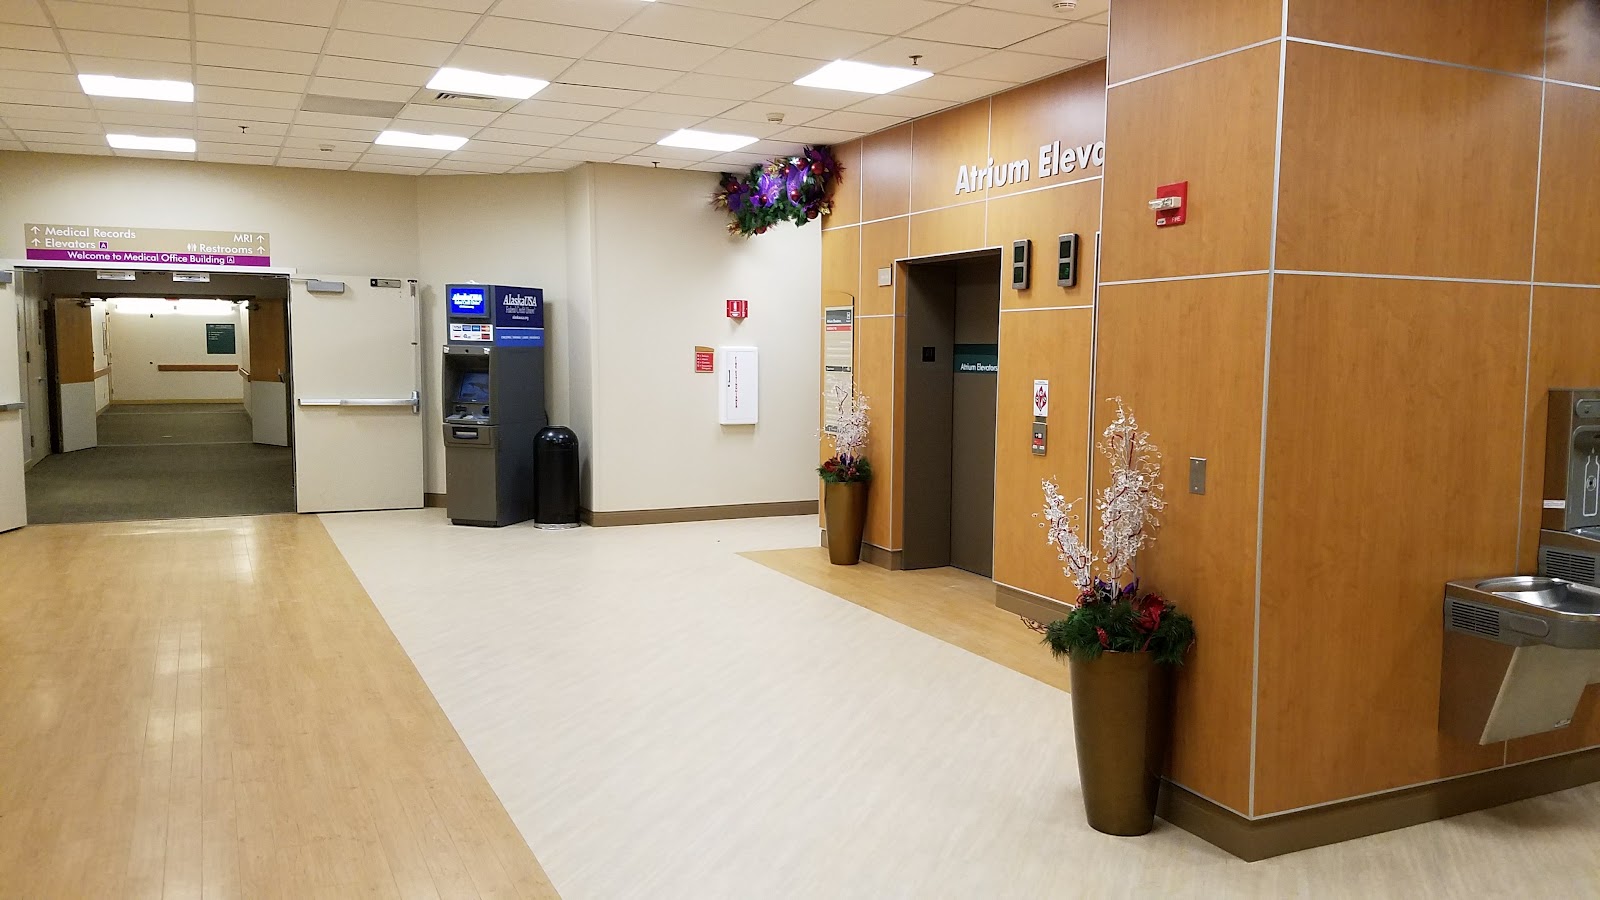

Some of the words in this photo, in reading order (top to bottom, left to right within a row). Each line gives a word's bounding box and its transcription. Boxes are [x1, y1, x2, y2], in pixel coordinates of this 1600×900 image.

[955, 156, 1030, 195] Atrium
[44, 226, 90, 237] Medical
[93, 228, 136, 239] Records
[233, 233, 253, 243] MRI
[45, 238, 96, 249] Elevators
[199, 243, 253, 254] Restrooms
[67, 251, 110, 261] Welcome
[112, 252, 122, 260] to
[123, 252, 159, 262] Medical
[160, 254, 188, 263] Office
[189, 255, 225, 265] Building
[503, 294, 537, 307] AlaskaUSA
[960, 363, 977, 371] Atrium
